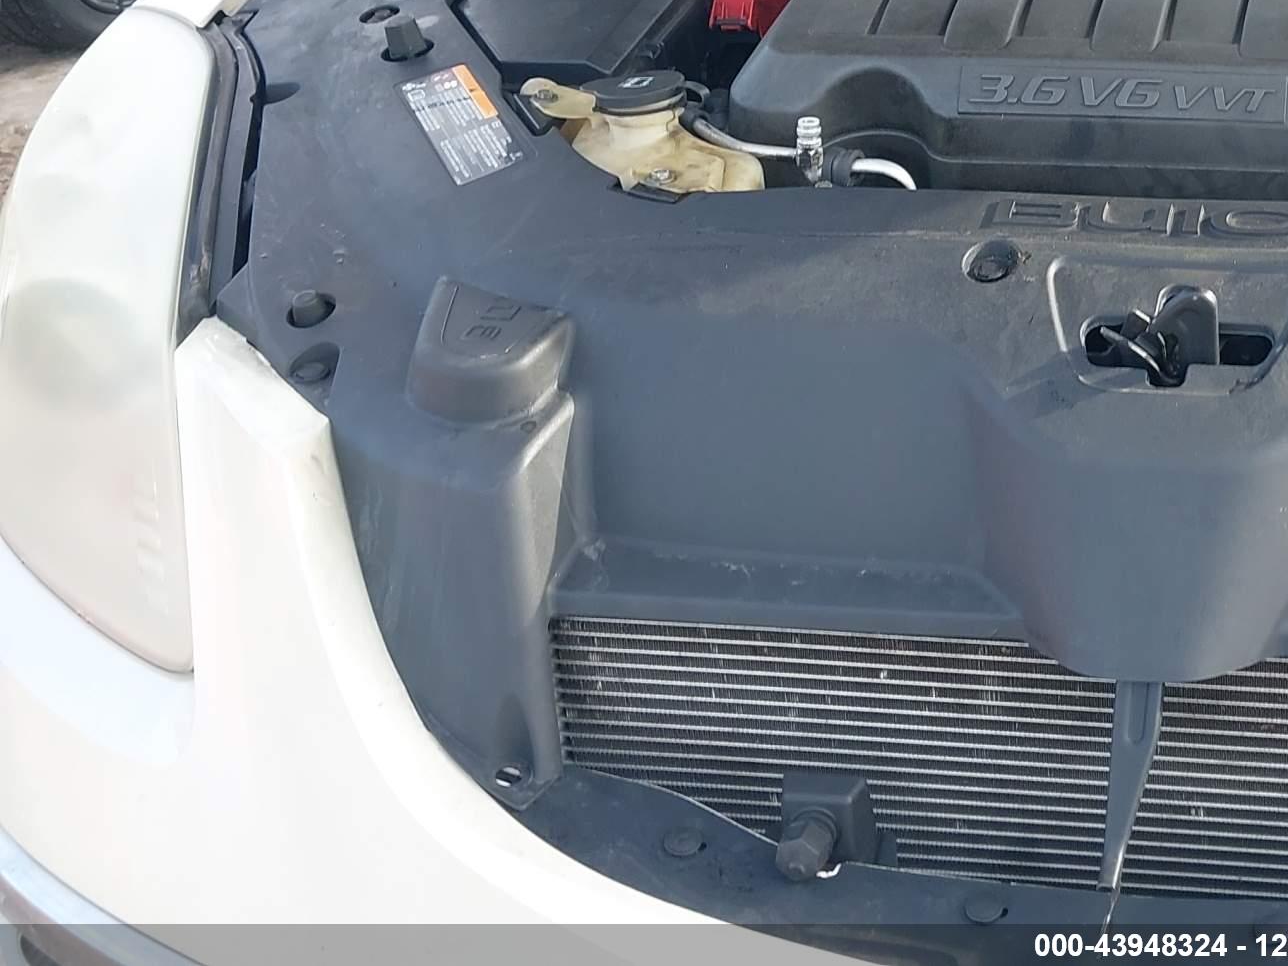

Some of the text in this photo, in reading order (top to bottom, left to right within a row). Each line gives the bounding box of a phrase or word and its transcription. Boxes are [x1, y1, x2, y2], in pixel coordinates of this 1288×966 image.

[968, 74, 1277, 113] 3.6 V6 VVT
